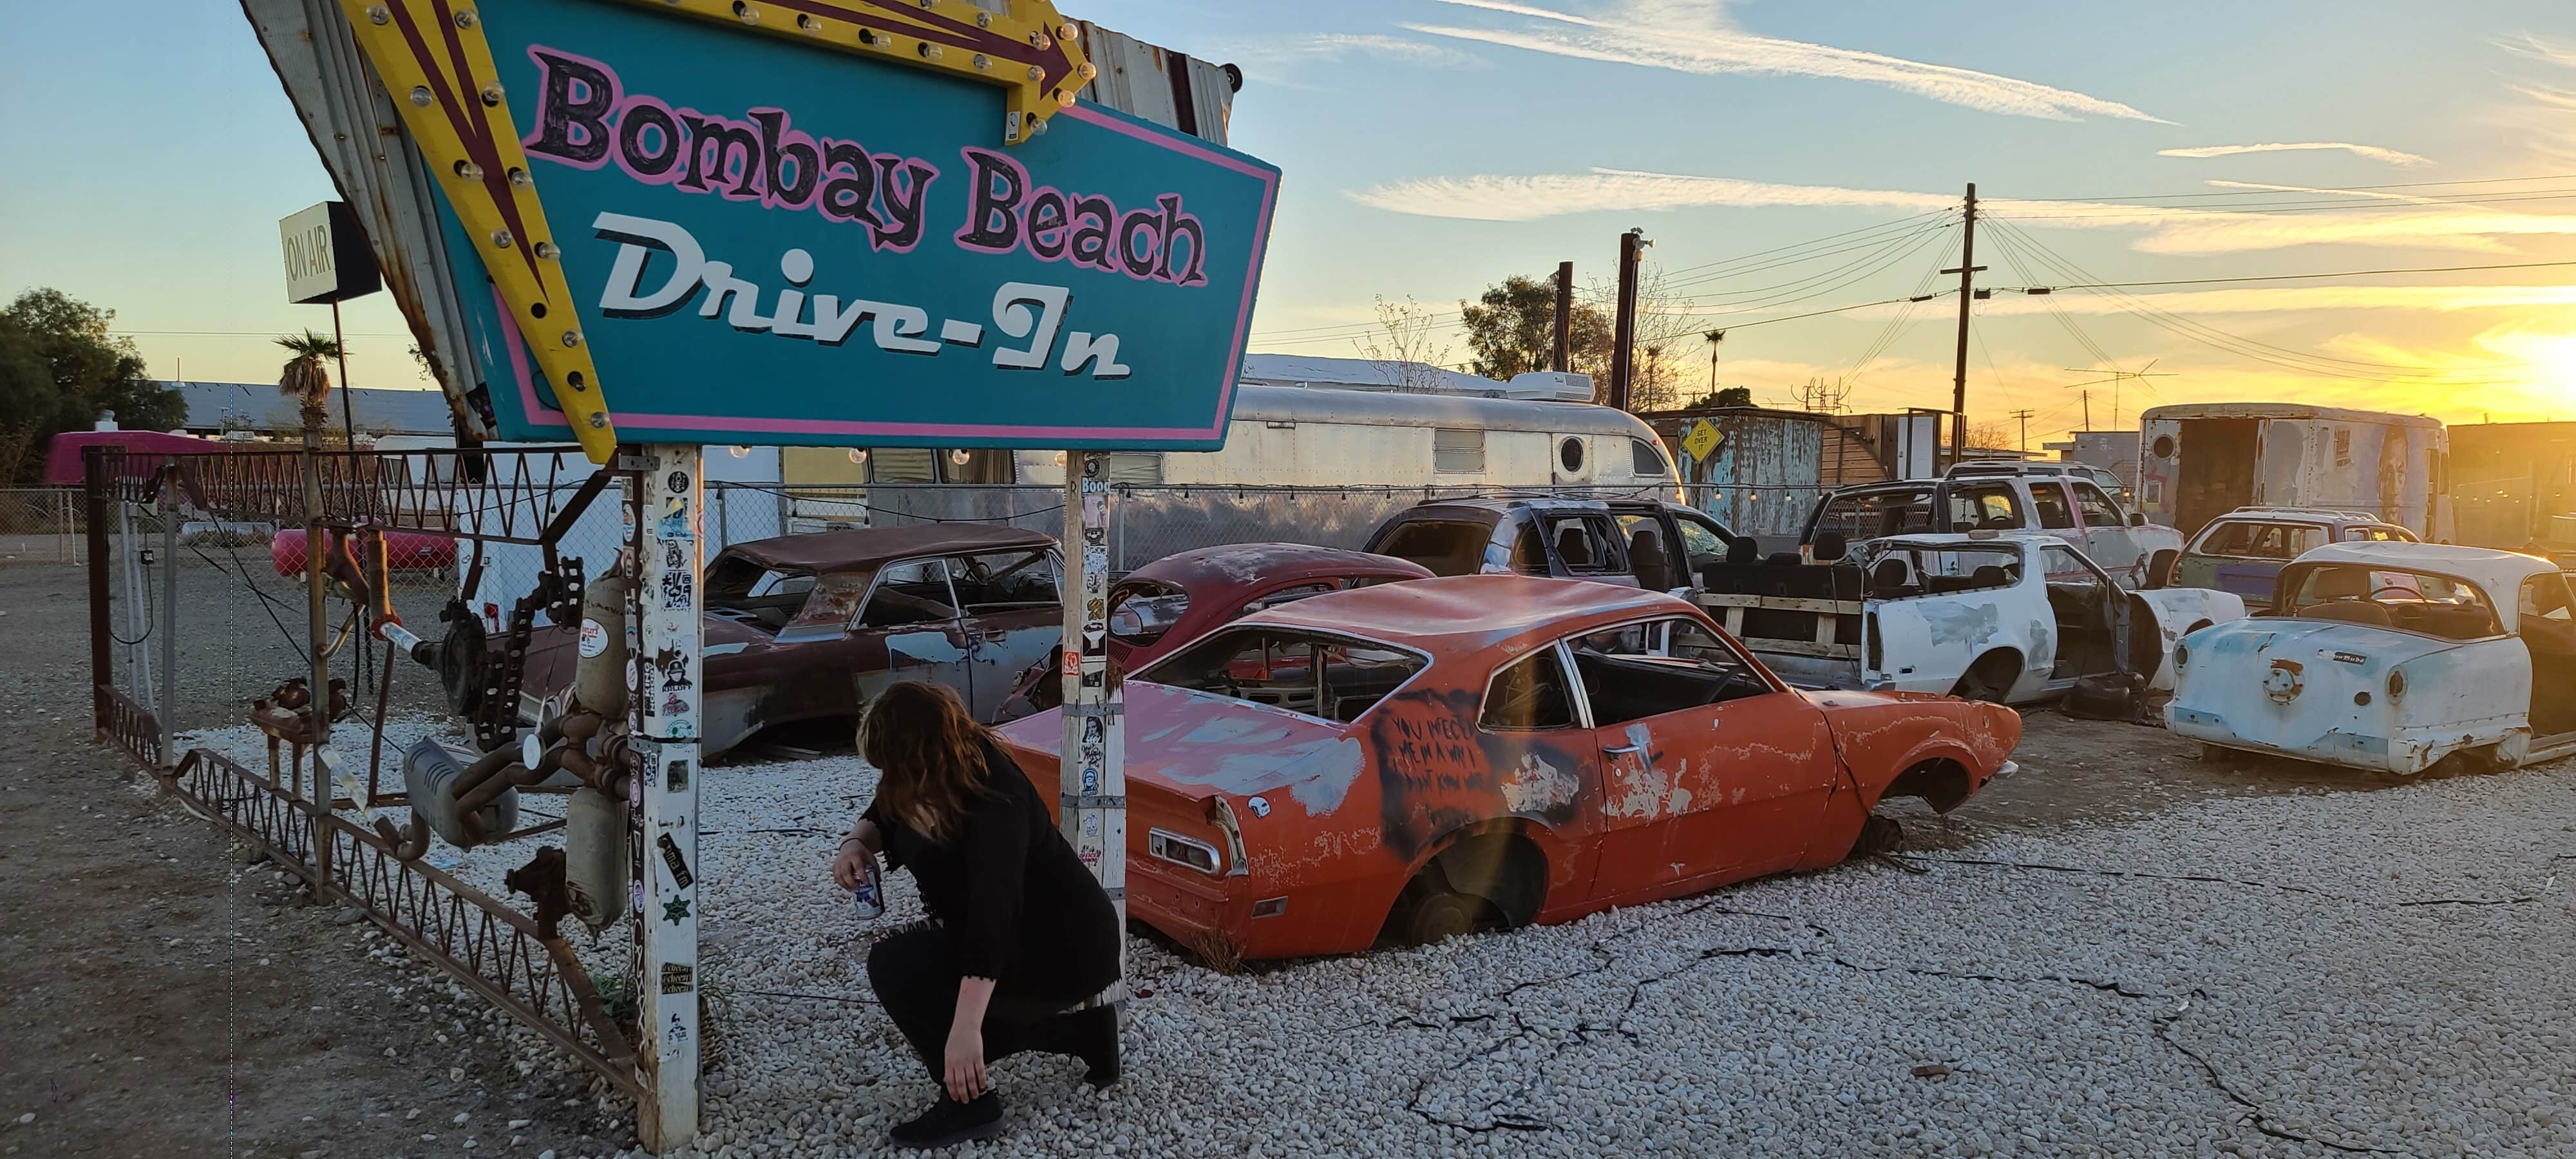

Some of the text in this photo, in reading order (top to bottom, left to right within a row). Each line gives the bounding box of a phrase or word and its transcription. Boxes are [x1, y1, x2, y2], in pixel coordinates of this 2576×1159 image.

[527, 50, 1206, 284] Bombay Beach
[288, 225, 331, 281] ON AIR
[592, 211, 1132, 380] Drive-In
[1391, 715, 1422, 740] YOU
[1398, 739, 1420, 769] ME
[1435, 740, 1447, 762] A
